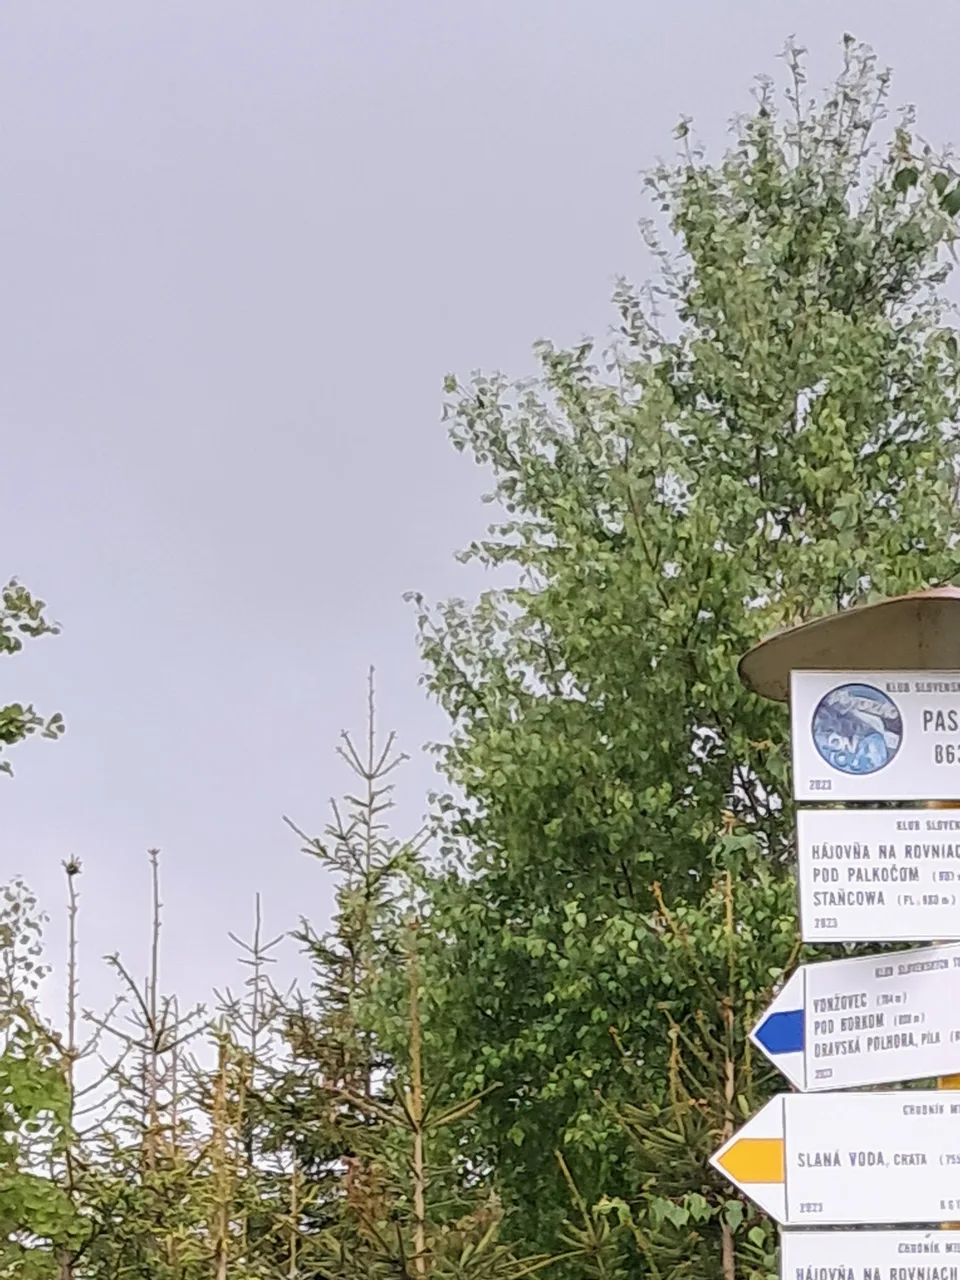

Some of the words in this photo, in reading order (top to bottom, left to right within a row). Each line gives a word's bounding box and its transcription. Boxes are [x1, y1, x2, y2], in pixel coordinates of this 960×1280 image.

[896, 820, 920, 831] KLUB
[812, 841, 871, 860] HÁJOVŇA
[878, 844, 897, 859] NA
[813, 867, 840, 883] POD
[847, 864, 920, 883] PALKOČOM
[814, 1020, 835, 1035] POD
[814, 1036, 861, 1058] ORAVSKÁ
[798, 1150, 841, 1167] SLANÁ
[849, 1152, 890, 1168] VODA,
